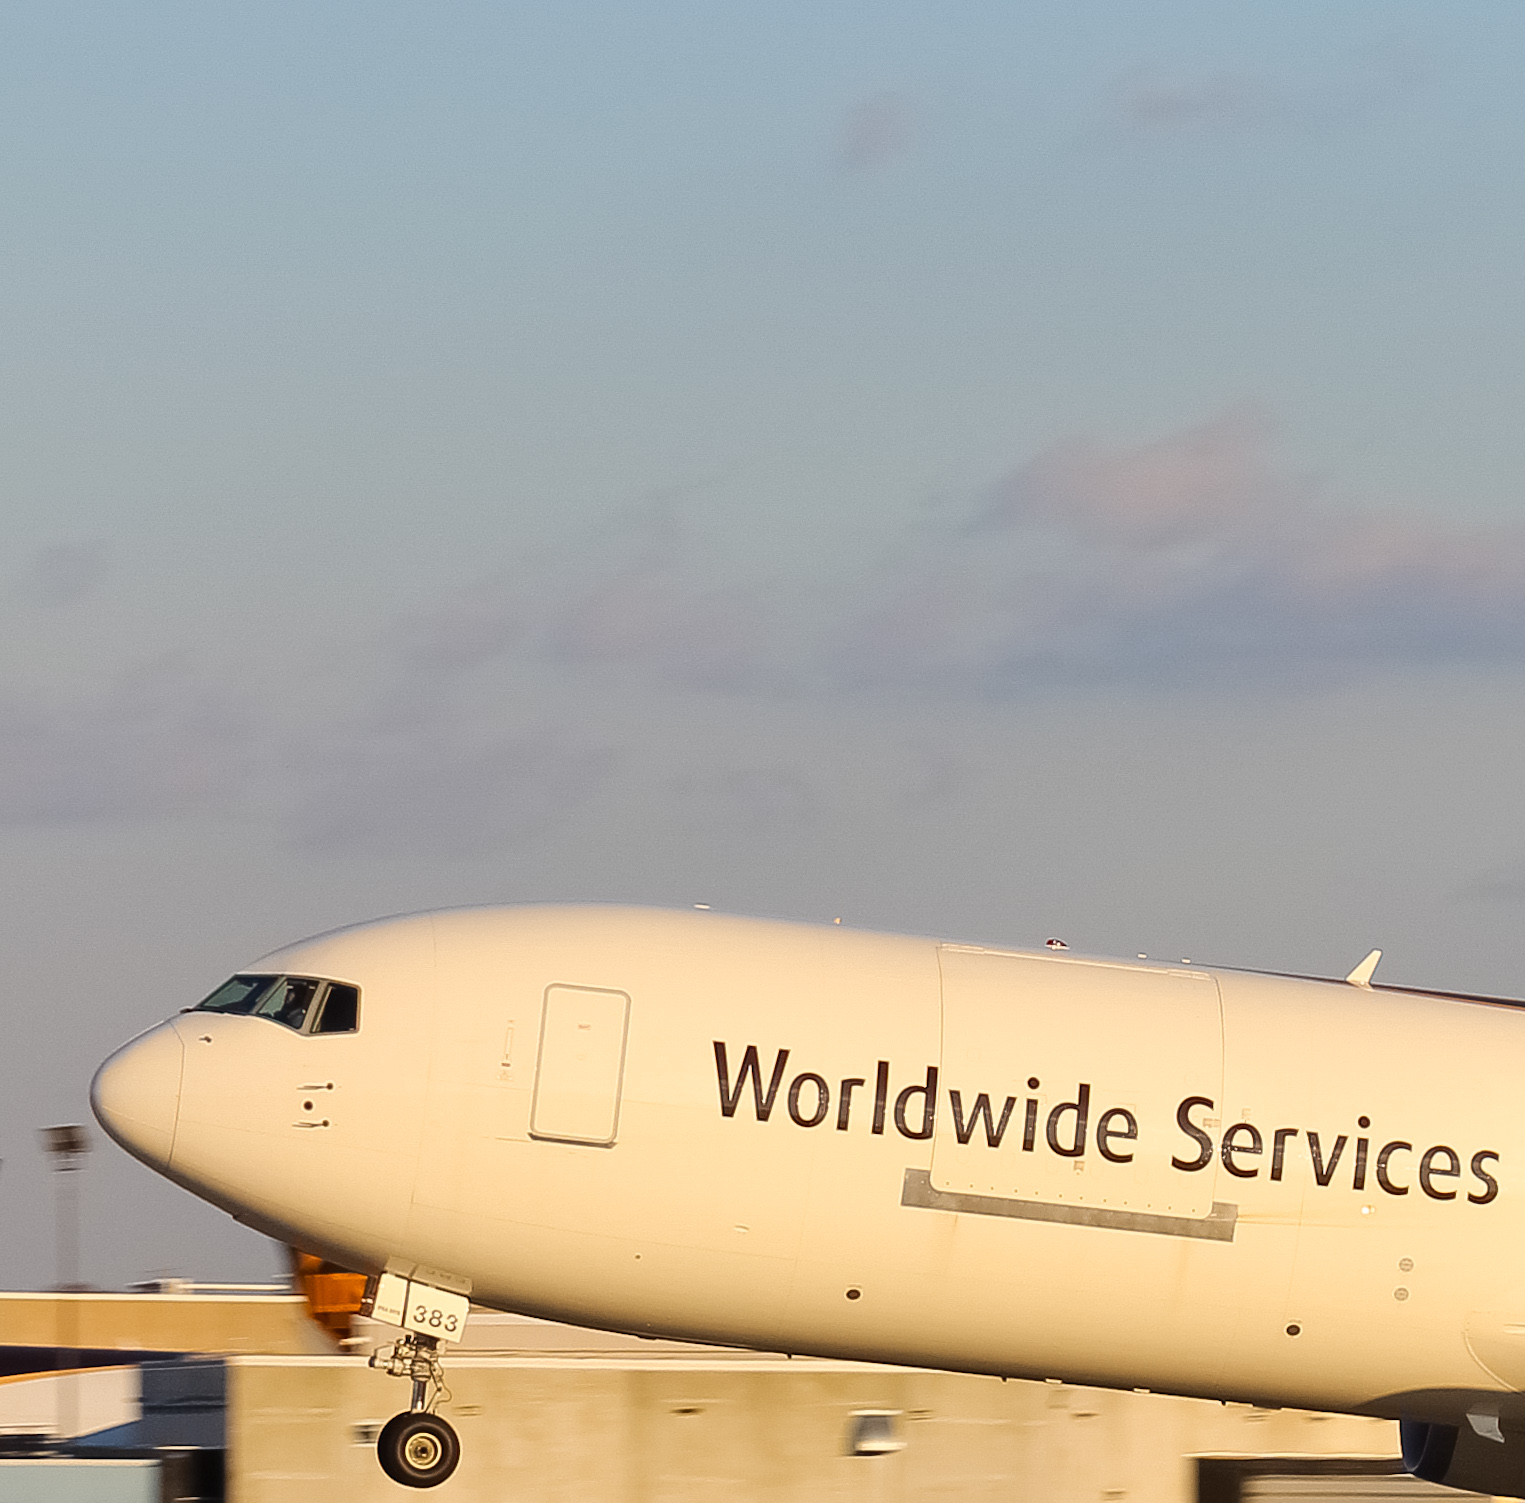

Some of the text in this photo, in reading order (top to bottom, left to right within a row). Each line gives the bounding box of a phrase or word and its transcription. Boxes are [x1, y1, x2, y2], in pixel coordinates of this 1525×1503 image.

[712, 1040, 1501, 1206] Worldwide Services
[412, 1304, 459, 1333] 383
